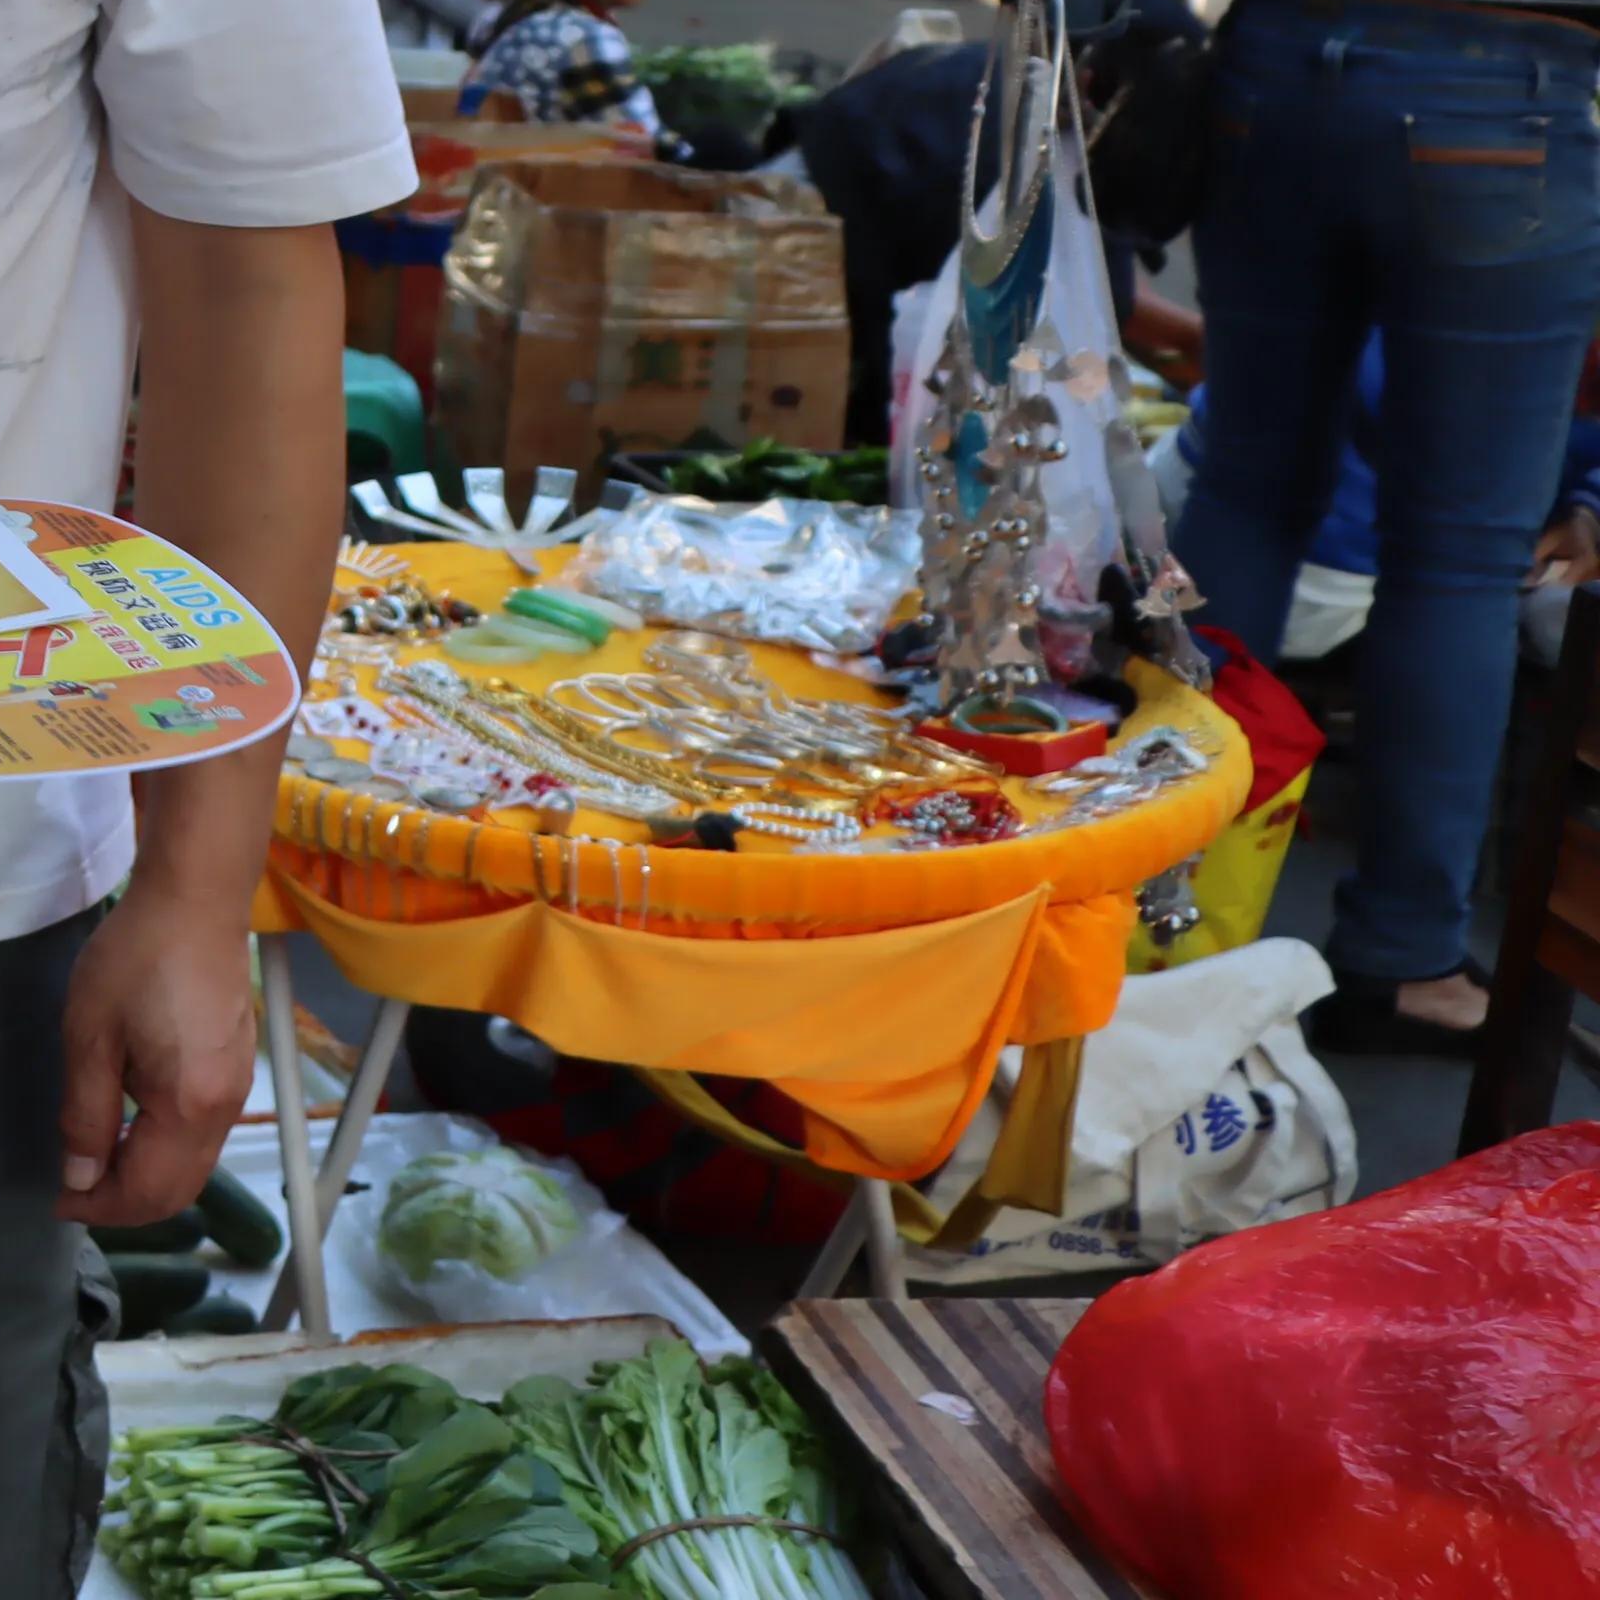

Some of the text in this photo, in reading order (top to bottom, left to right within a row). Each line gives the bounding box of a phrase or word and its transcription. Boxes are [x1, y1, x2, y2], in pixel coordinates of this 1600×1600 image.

[75, 559, 200, 651] 预防艾滋病
[137, 567, 242, 629] AIDS
